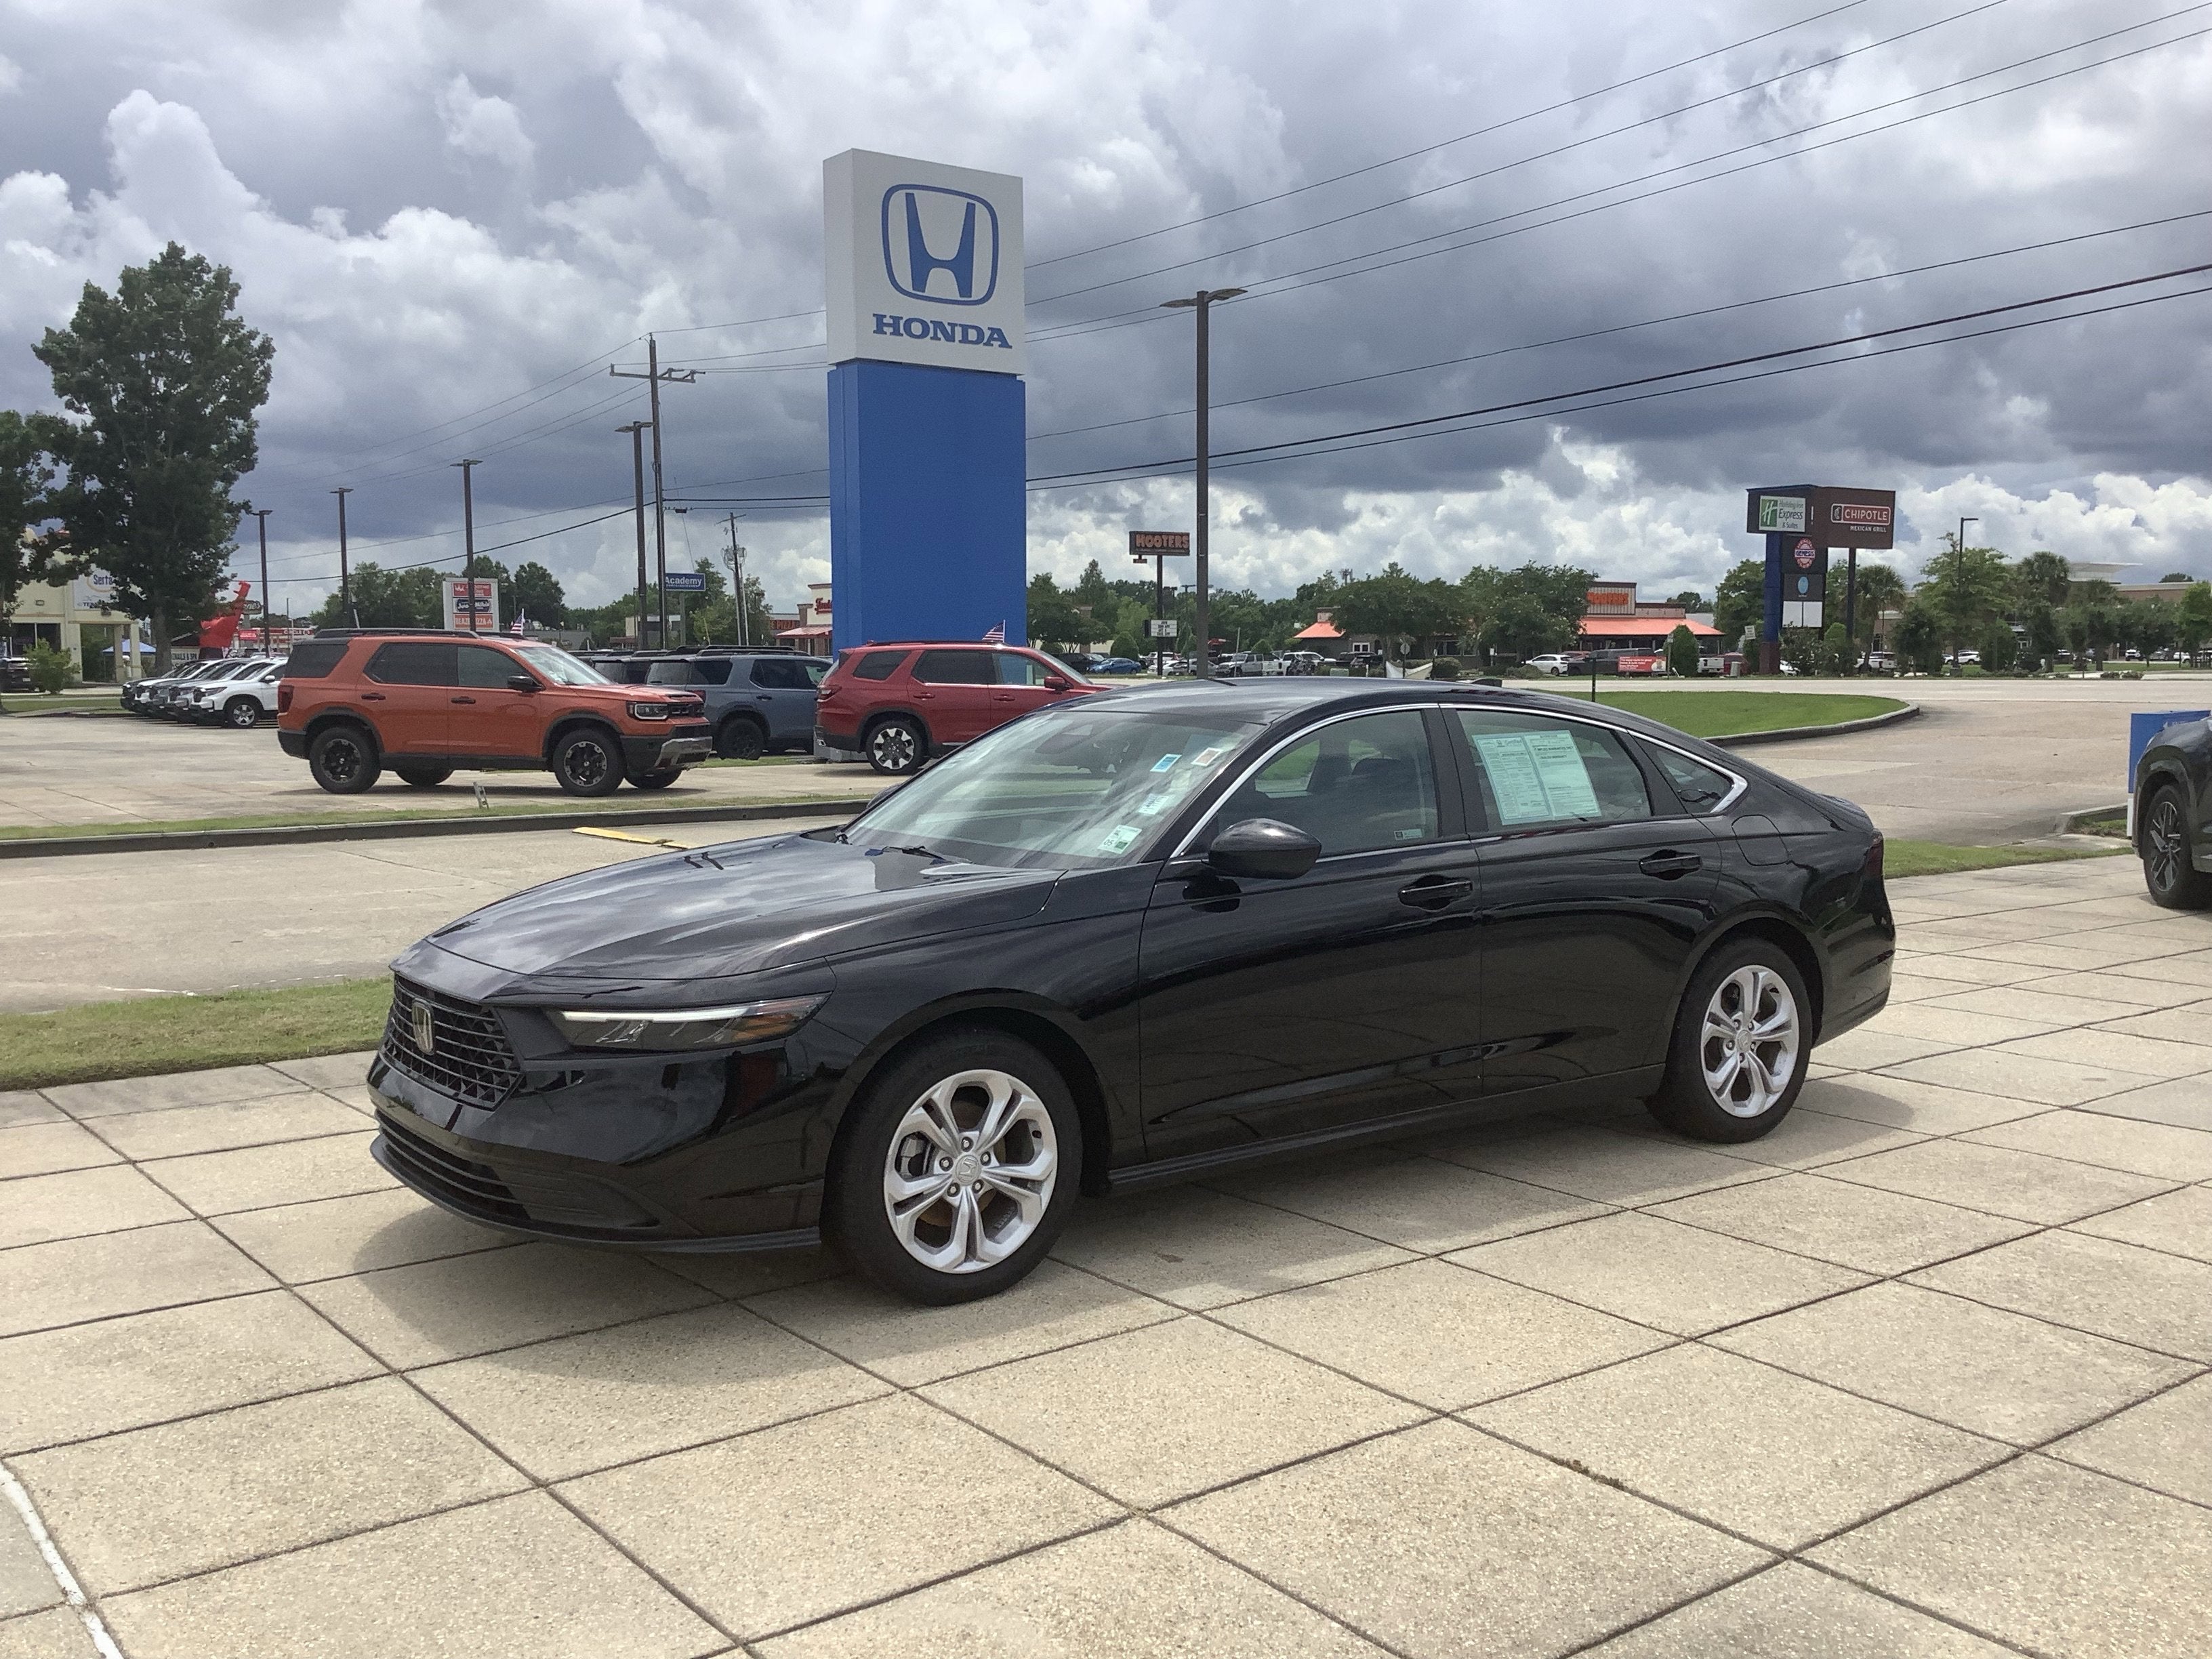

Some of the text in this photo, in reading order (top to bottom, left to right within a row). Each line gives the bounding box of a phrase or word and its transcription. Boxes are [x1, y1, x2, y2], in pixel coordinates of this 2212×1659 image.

[872, 312, 1012, 349] HONDA
[1778, 508, 1803, 521] Express
[1845, 509, 1888, 520] CHIPOTLE
[1136, 534, 1190, 548] HOOTERS
[665, 576, 702, 588] Academy
